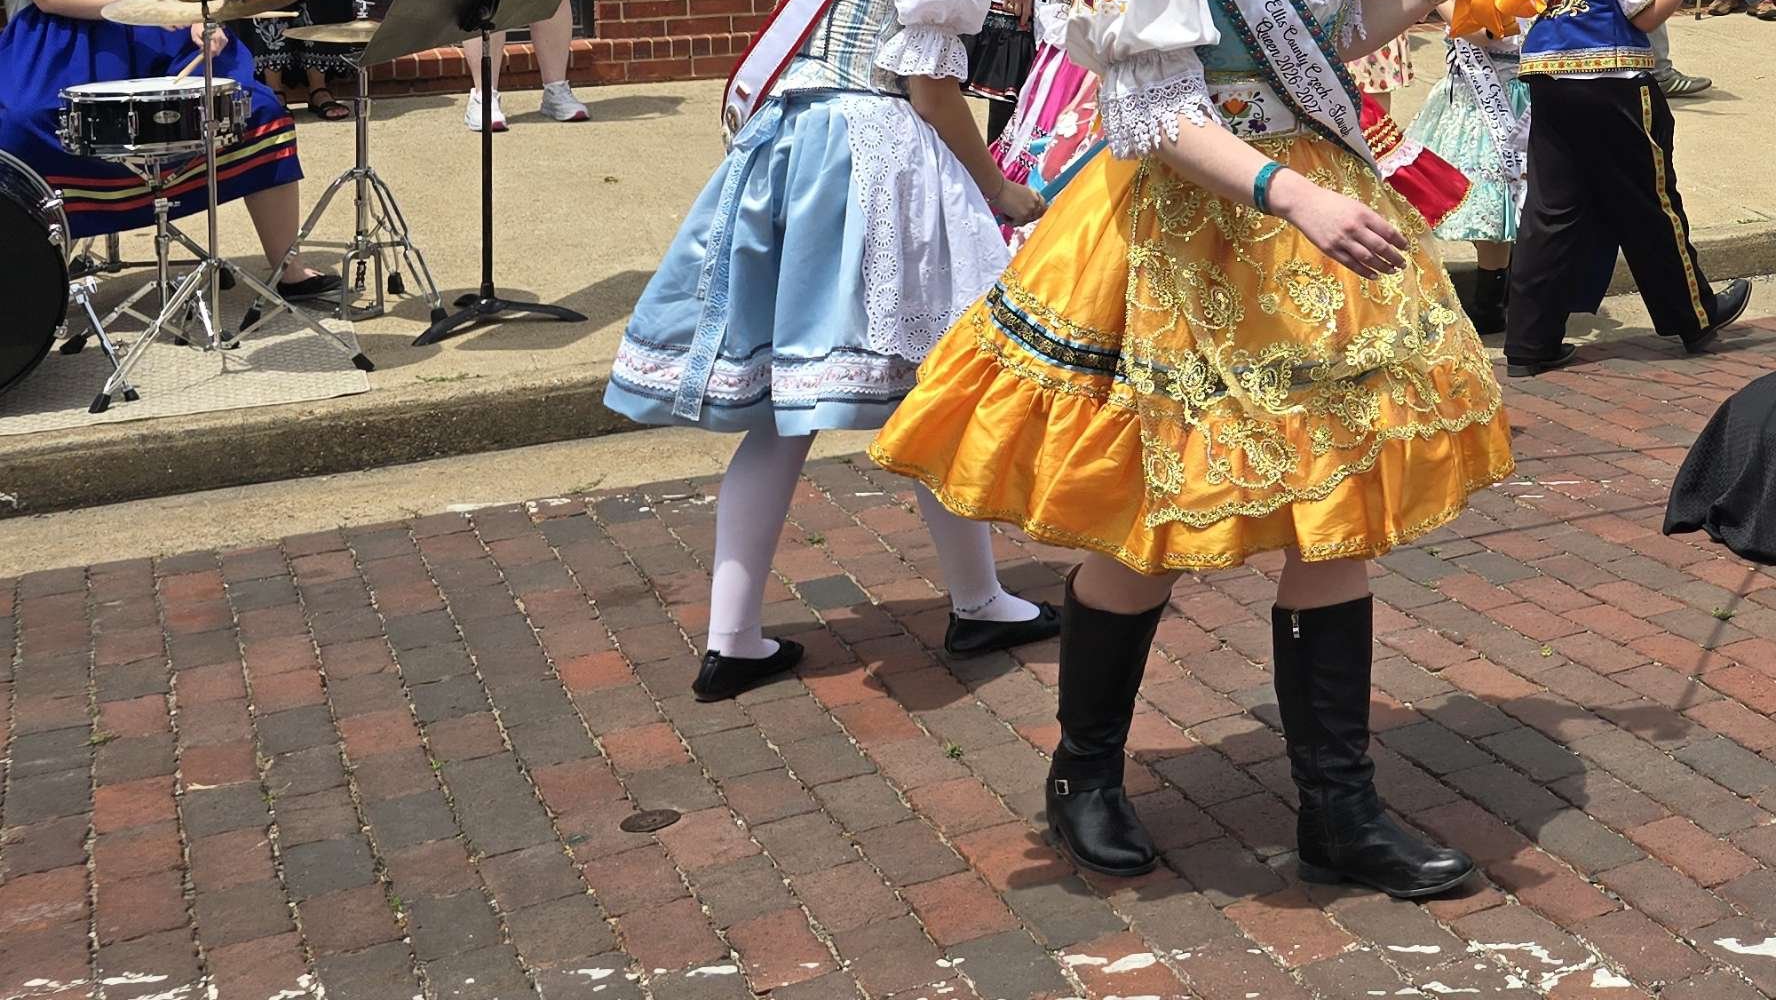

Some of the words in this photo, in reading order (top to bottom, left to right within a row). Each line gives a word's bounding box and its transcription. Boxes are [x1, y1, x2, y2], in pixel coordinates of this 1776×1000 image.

[1255, 16, 1281, 58] Queen
[1275, 55, 1322, 114] 2026-2027
[1283, 24, 1309, 70] County
[1304, 63, 1333, 100] Czech
[1328, 103, 1354, 137] Slovak
